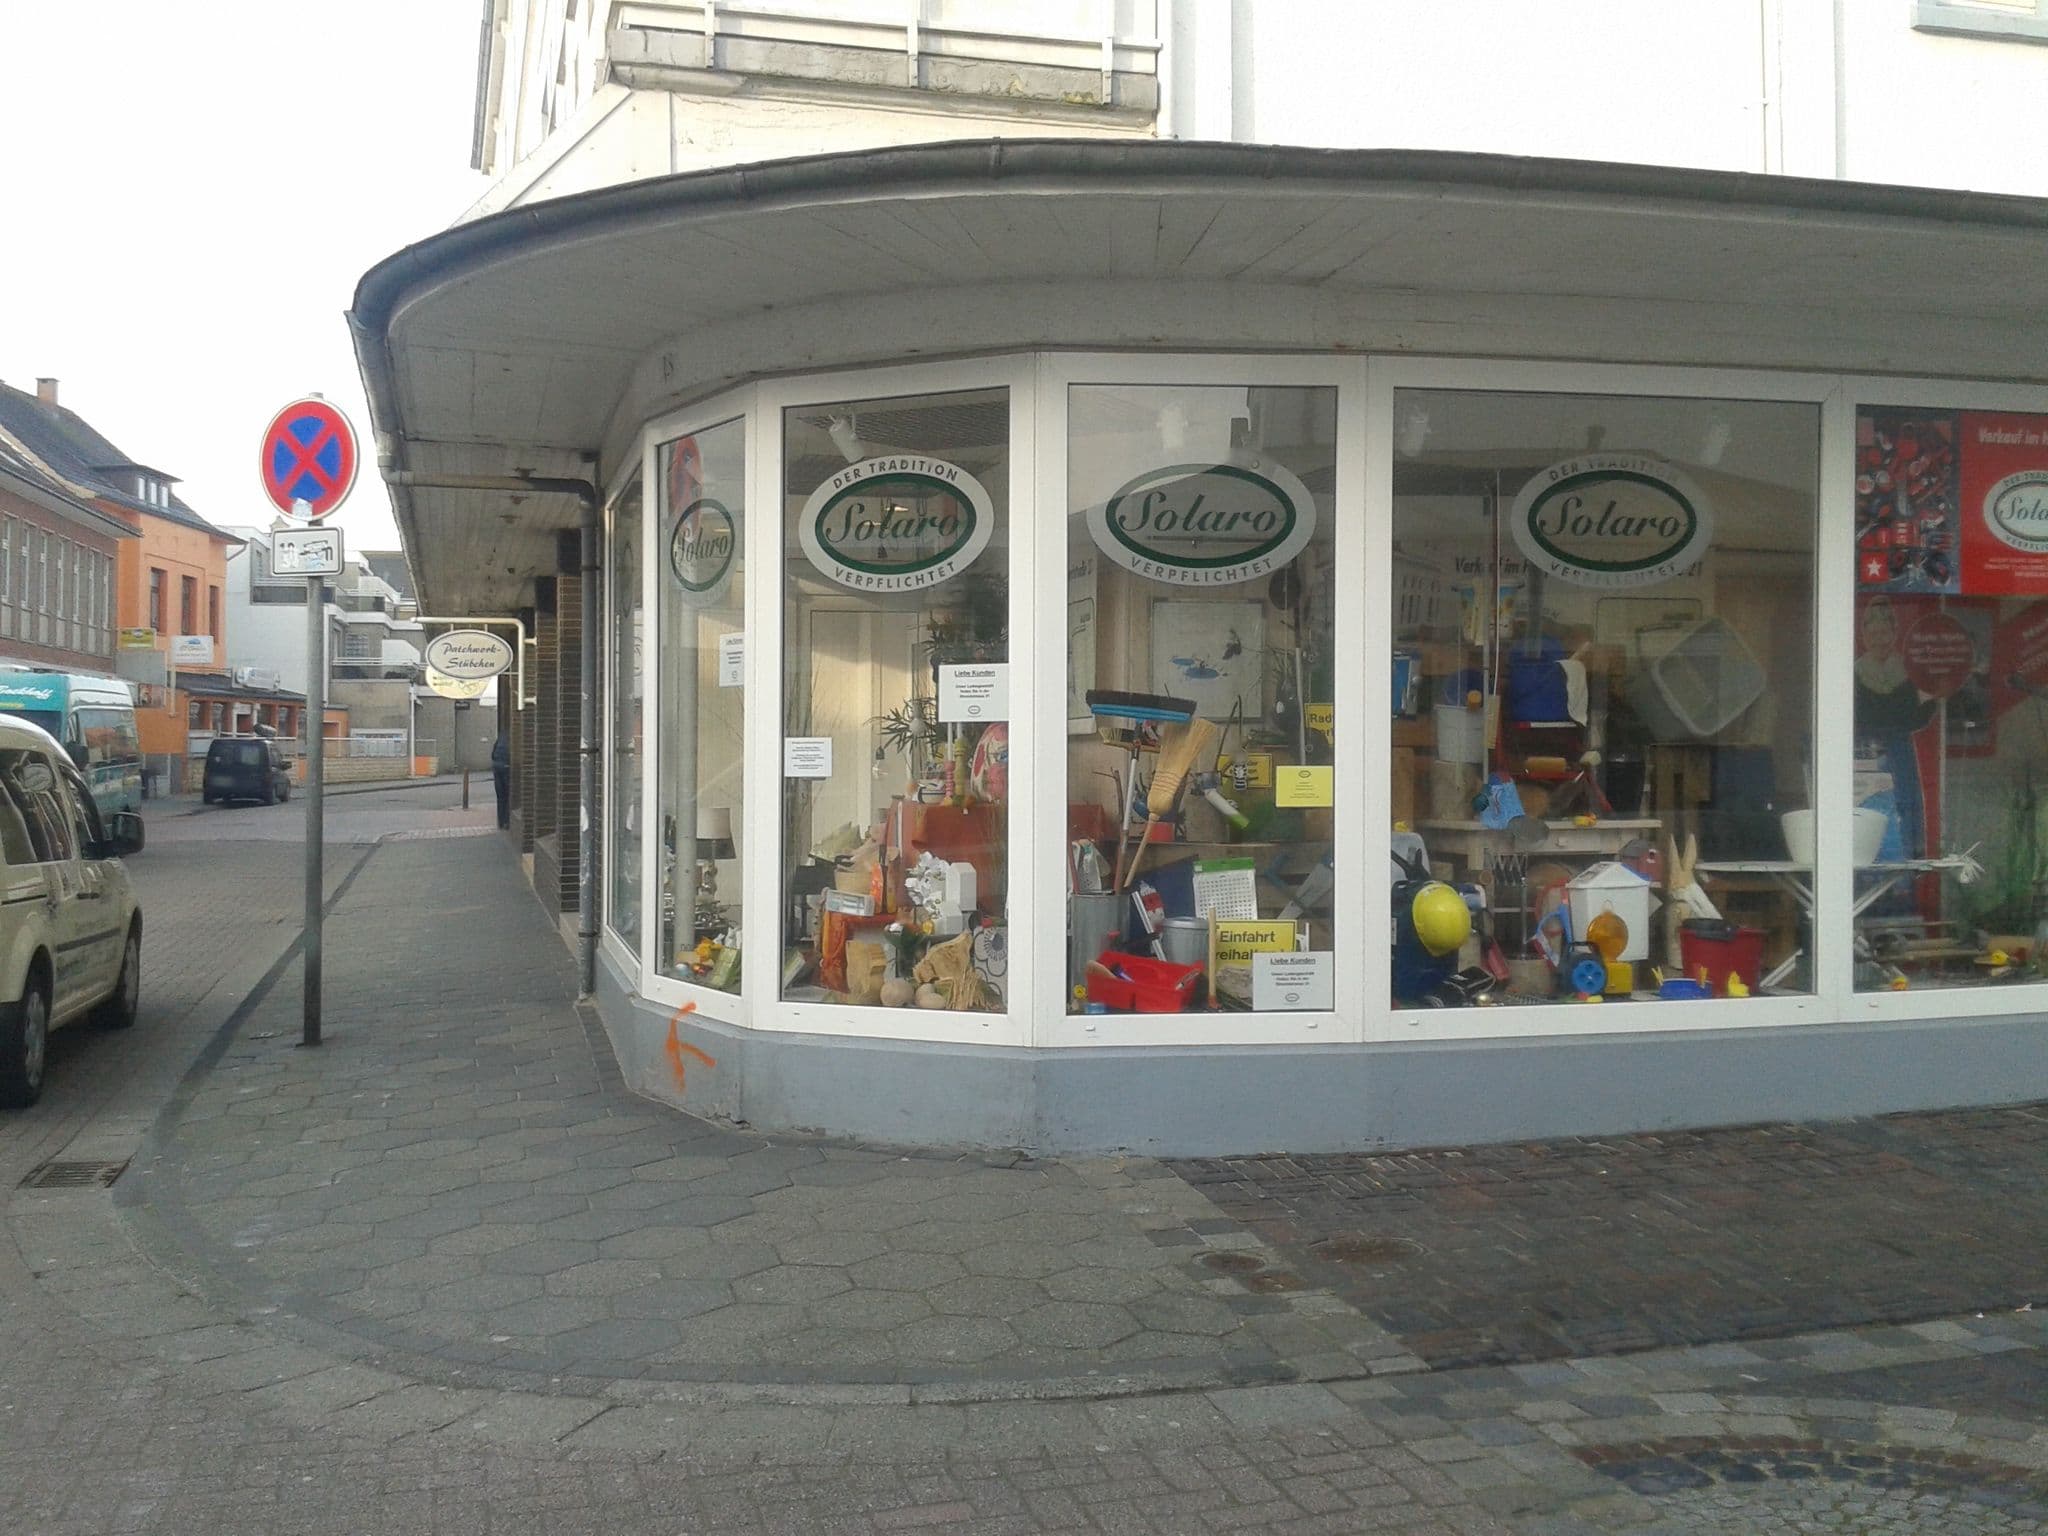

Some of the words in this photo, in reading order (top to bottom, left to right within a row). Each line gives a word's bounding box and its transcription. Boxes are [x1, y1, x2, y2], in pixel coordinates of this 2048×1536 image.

[833, 468, 861, 489] DER
[869, 459, 958, 482] TRADITION
[1549, 462, 1578, 480] DER
[825, 503, 959, 543] Solaro
[1118, 491, 1276, 532] Solaro
[1538, 496, 1681, 537] Solaro
[674, 527, 729, 566] Solaro
[834, 561, 955, 589] VERPFLICHTET
[1131, 556, 1273, 582] VERPFLICHTET
[445, 657, 495, 669] Stübchen
[1220, 931, 1275, 943] Einfahrt
[1289, 957, 1316, 965] Kunden
